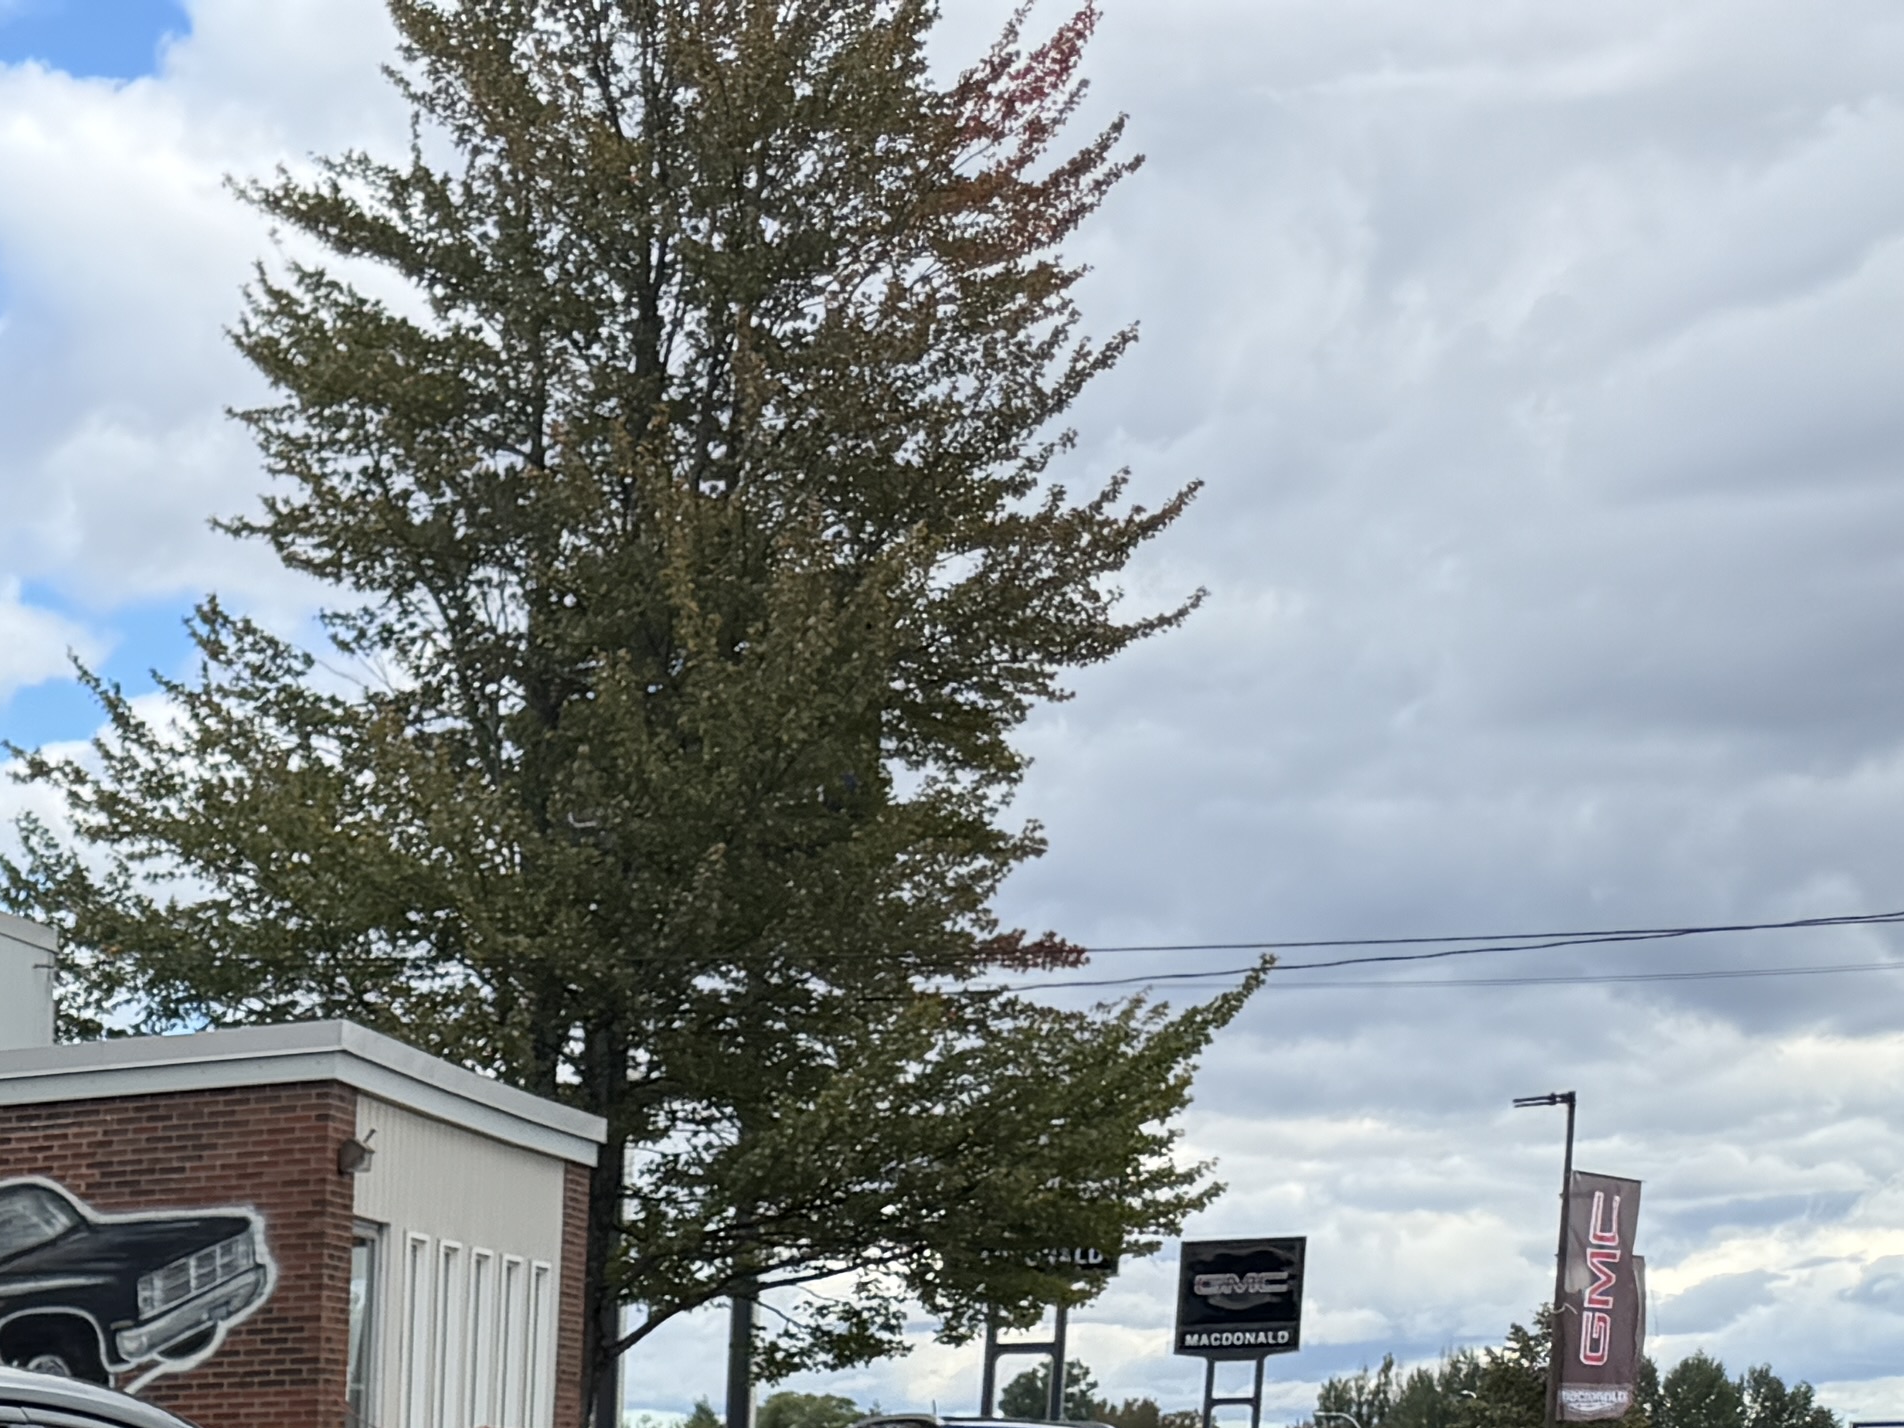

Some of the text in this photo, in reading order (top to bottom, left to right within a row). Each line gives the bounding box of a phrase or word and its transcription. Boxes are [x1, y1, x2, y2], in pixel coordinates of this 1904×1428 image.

[1193, 1271, 1289, 1296] GMC
[1579, 1190, 1621, 1366] GMC
[1184, 1330, 1290, 1347] MACDONALD
